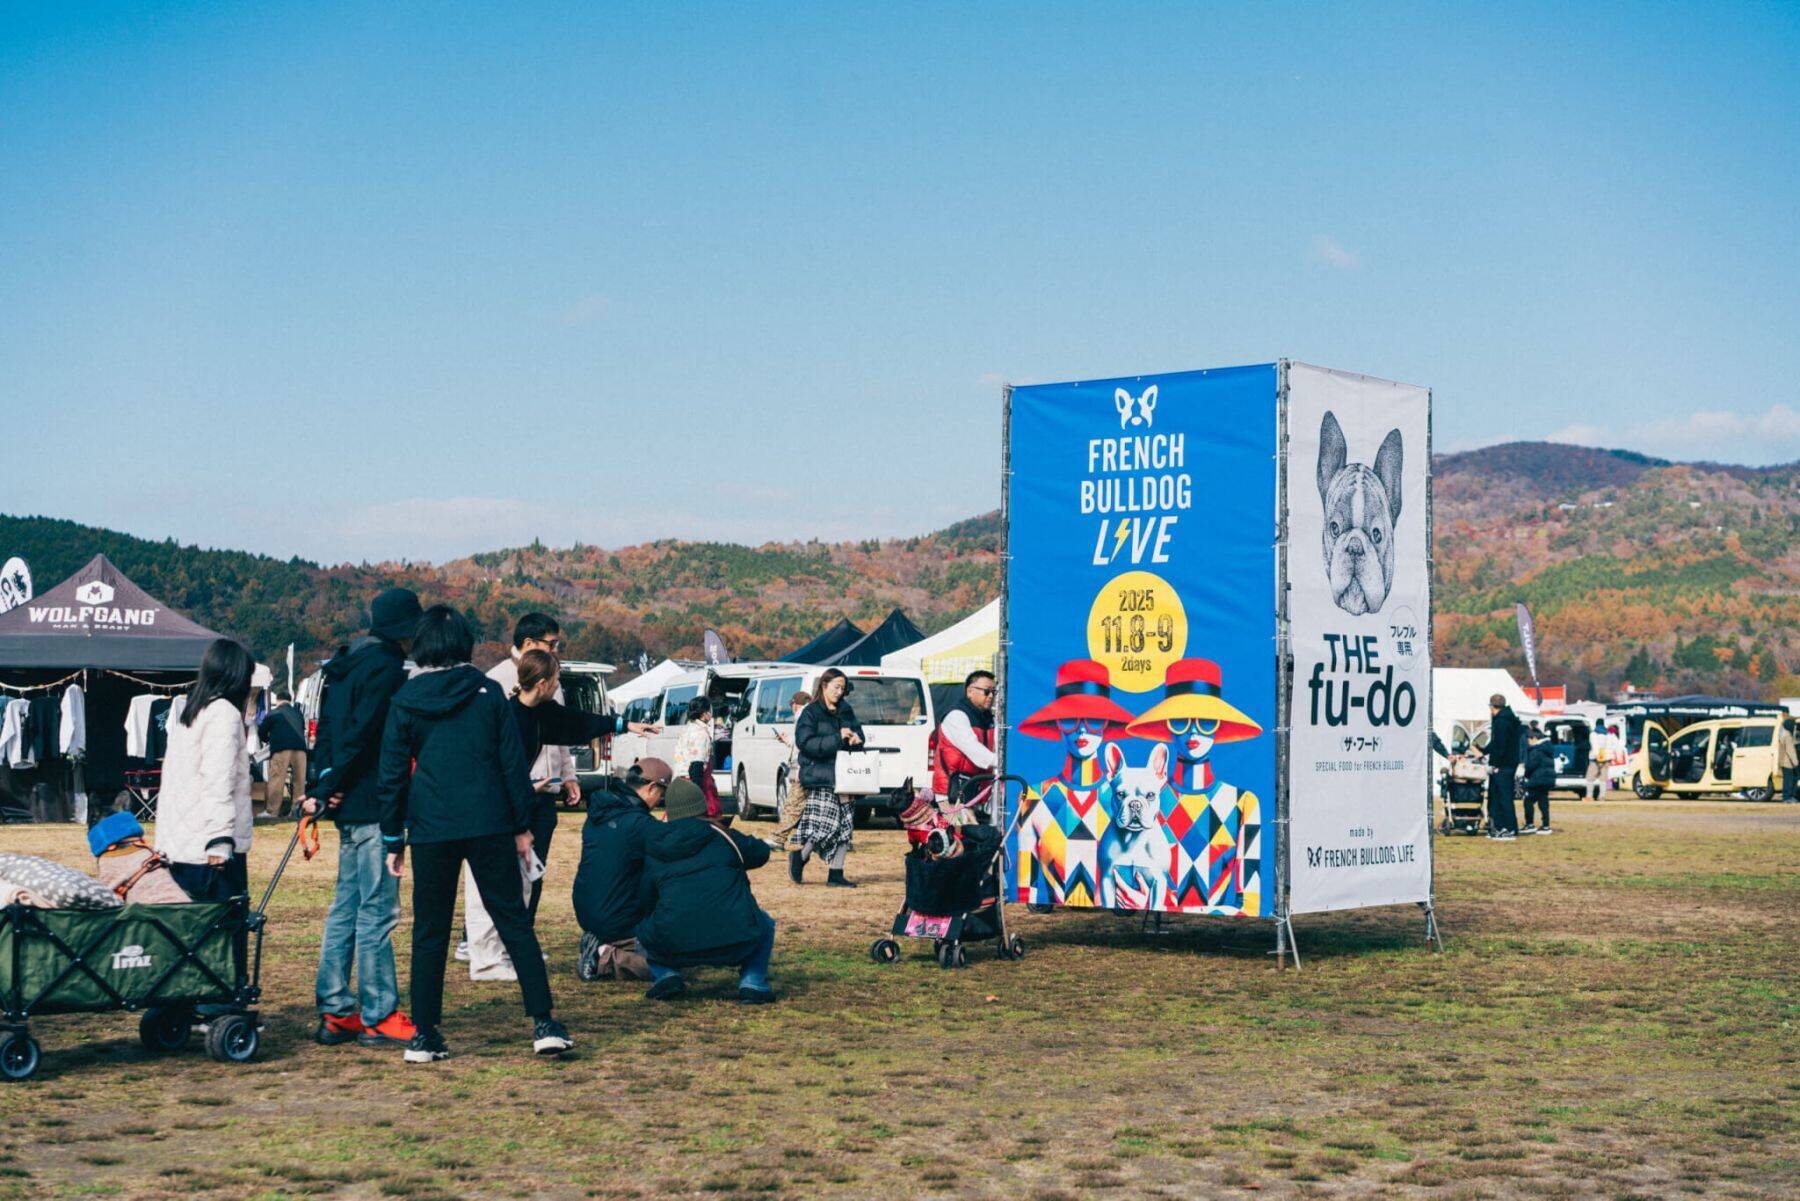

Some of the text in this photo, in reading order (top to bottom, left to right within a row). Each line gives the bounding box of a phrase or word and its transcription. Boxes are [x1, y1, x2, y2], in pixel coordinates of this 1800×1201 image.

[1088, 433, 1185, 473] FRENCH
[1080, 473, 1192, 514] BULLDOG
[1092, 515, 1179, 565] LIVE
[28, 606, 155, 625] WOLFGANG
[1119, 589, 1155, 611] 2025
[1101, 614, 1174, 653] 11.8-9
[1121, 656, 1152, 674] 2days
[1323, 633, 1381, 674] THE
[1308, 662, 1417, 727] fu-do
[1315, 762, 1337, 772] SPECIAL
[1338, 761, 1353, 772] FOOD
[1363, 761, 1382, 771] FRENCH
[1383, 760, 1404, 771] BULLDOG
[1349, 826, 1365, 837] made
[1325, 845, 1415, 868] FRENCH BULLDOG LIFE
